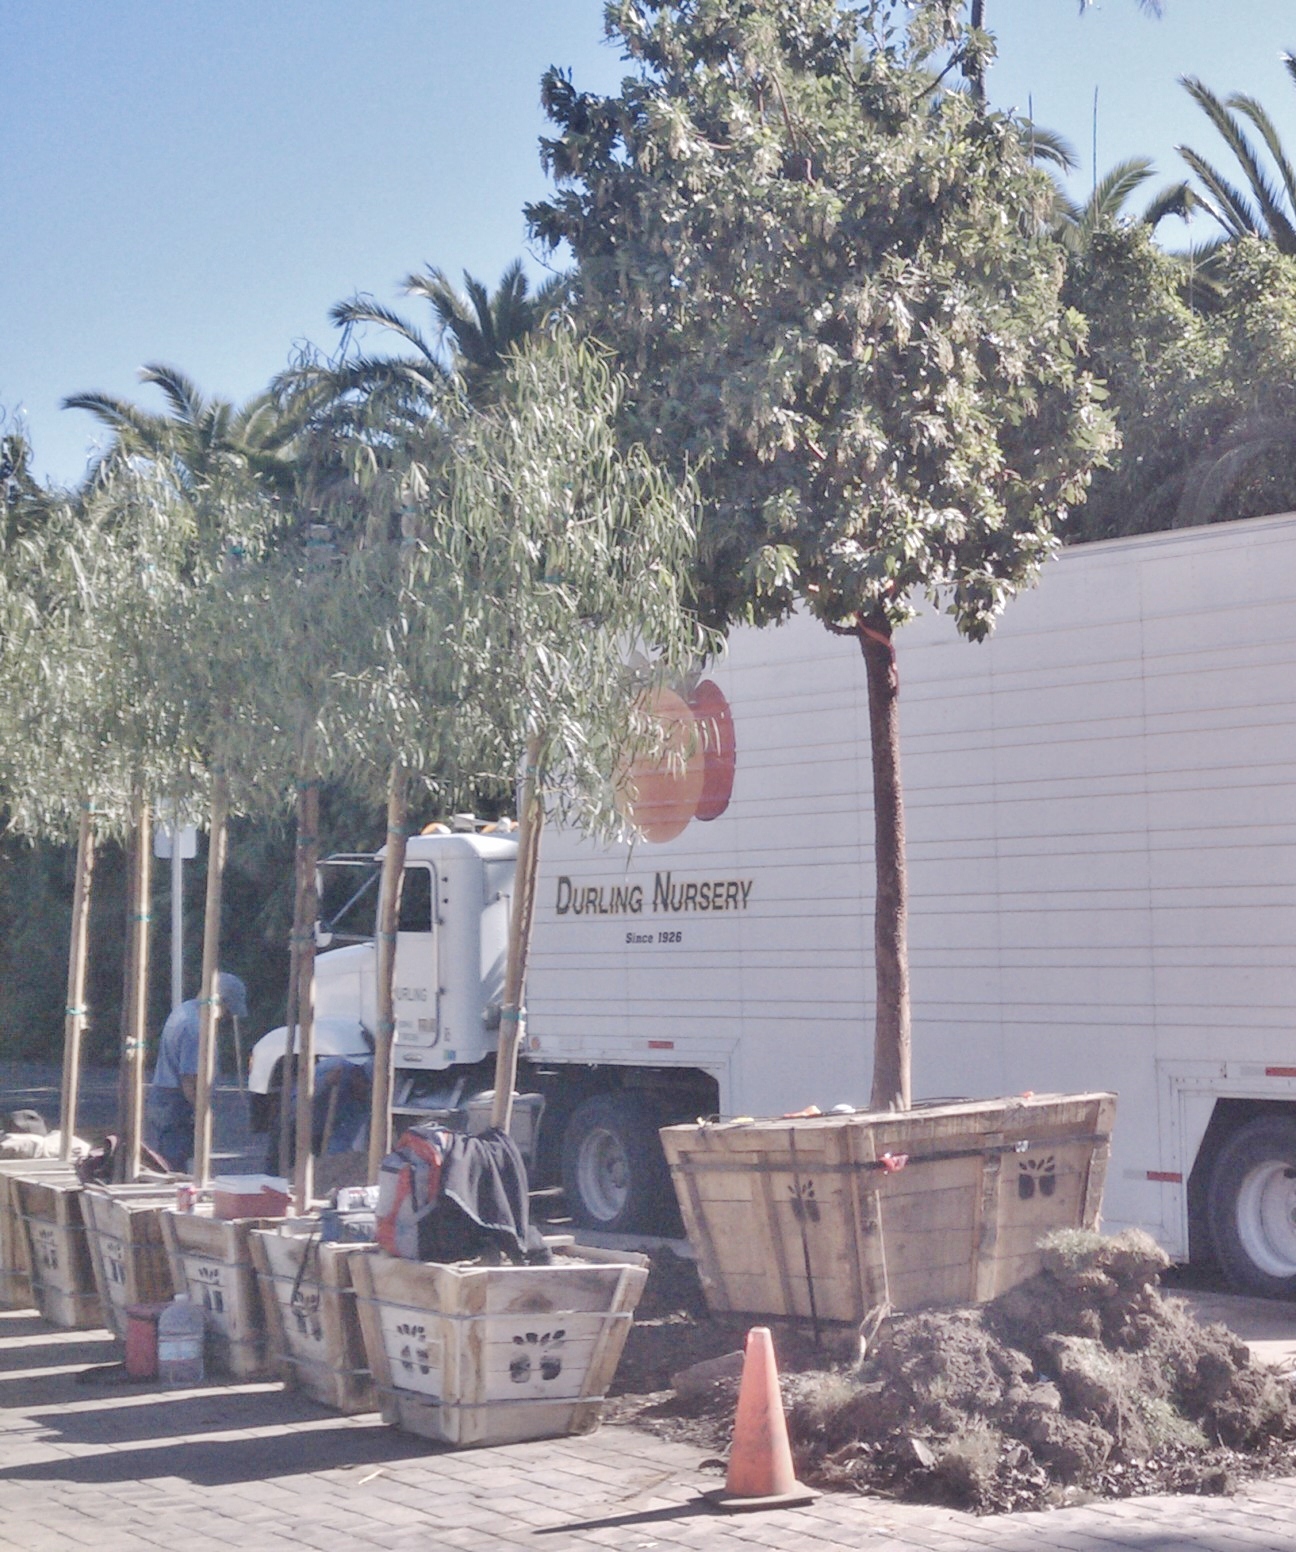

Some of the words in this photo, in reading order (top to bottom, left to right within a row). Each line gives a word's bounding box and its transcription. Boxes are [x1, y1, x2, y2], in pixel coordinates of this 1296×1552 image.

[556, 876, 643, 915] DURLING
[652, 871, 753, 912] NURSERY
[625, 932, 654, 944] Since
[658, 931, 682, 943] 1926
